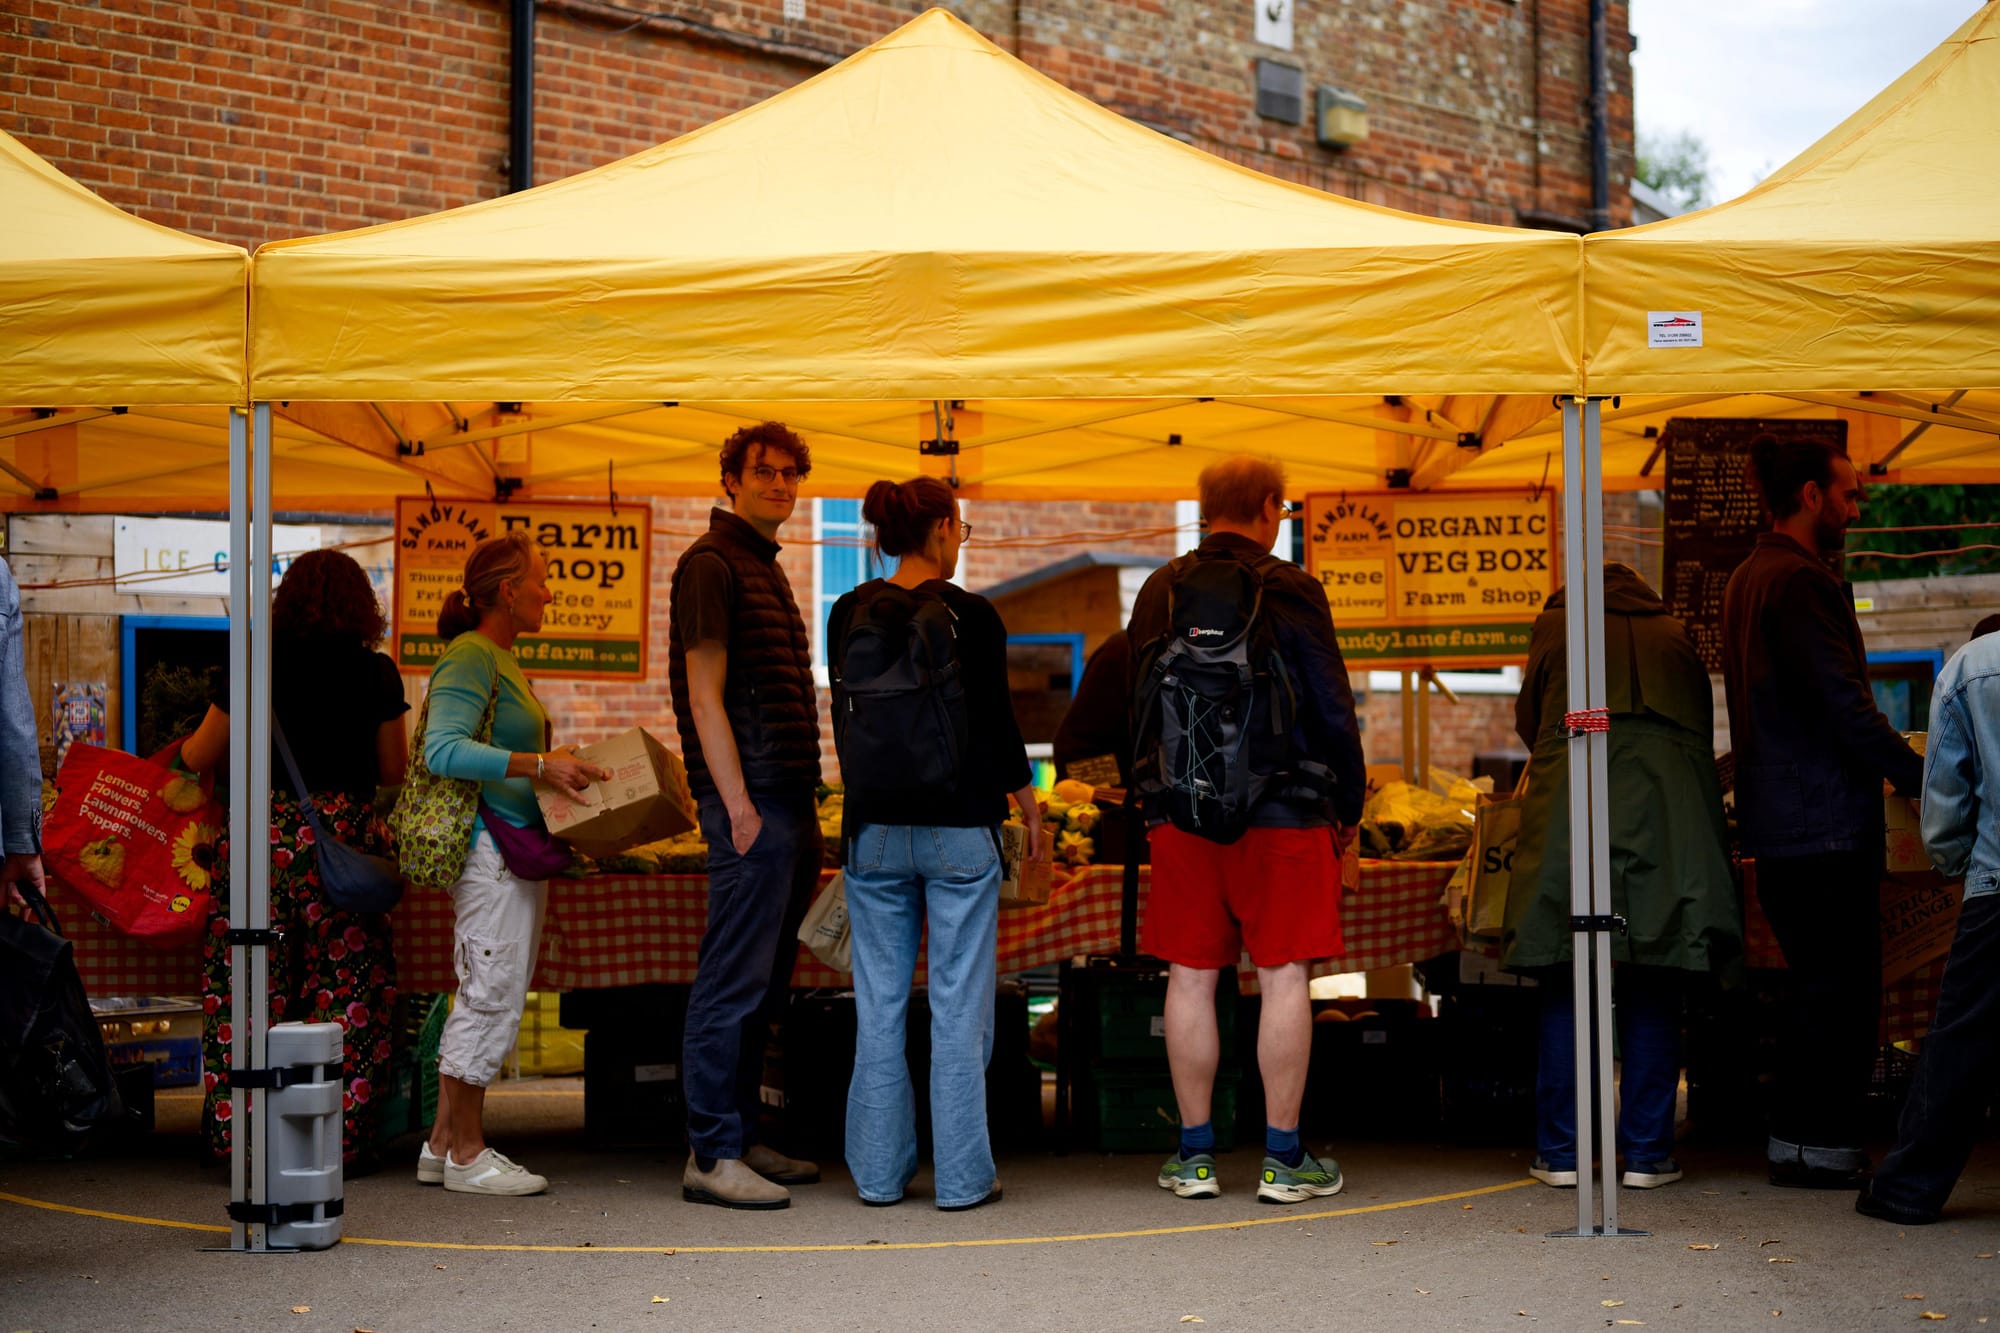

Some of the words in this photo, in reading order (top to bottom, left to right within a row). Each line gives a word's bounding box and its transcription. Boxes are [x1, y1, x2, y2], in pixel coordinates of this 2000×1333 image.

[402, 506, 452, 549] SANDY
[457, 509, 489, 541] LAN
[501, 515, 639, 550] Farm
[1313, 503, 1356, 542] SANDY
[1361, 505, 1392, 541] LANE
[1396, 515, 1547, 539] ORGANIC
[428, 539, 466, 550] FARM
[1336, 533, 1369, 542] FARM
[143, 547, 190, 571] ICE
[541, 551, 624, 588] hop
[1397, 551, 1468, 574] VEG
[1476, 549, 1548, 573] BOX
[409, 571, 463, 583] Thursd
[1321, 570, 1383, 585] Free
[1468, 576, 1478, 587] &
[416, 590, 443, 600] Fri
[552, 590, 594, 607] fee
[605, 598, 633, 608] and
[1330, 597, 1385, 608] elivery
[1405, 590, 1466, 607] Farm
[1482, 587, 1542, 606] Shop
[543, 610, 613, 630] kery
[97, 770, 150, 801] Lemons,
[90, 782, 143, 814] Flowers,
[79, 805, 132, 840] Peppers.
[83, 793, 168, 845] Lawnmowers,
